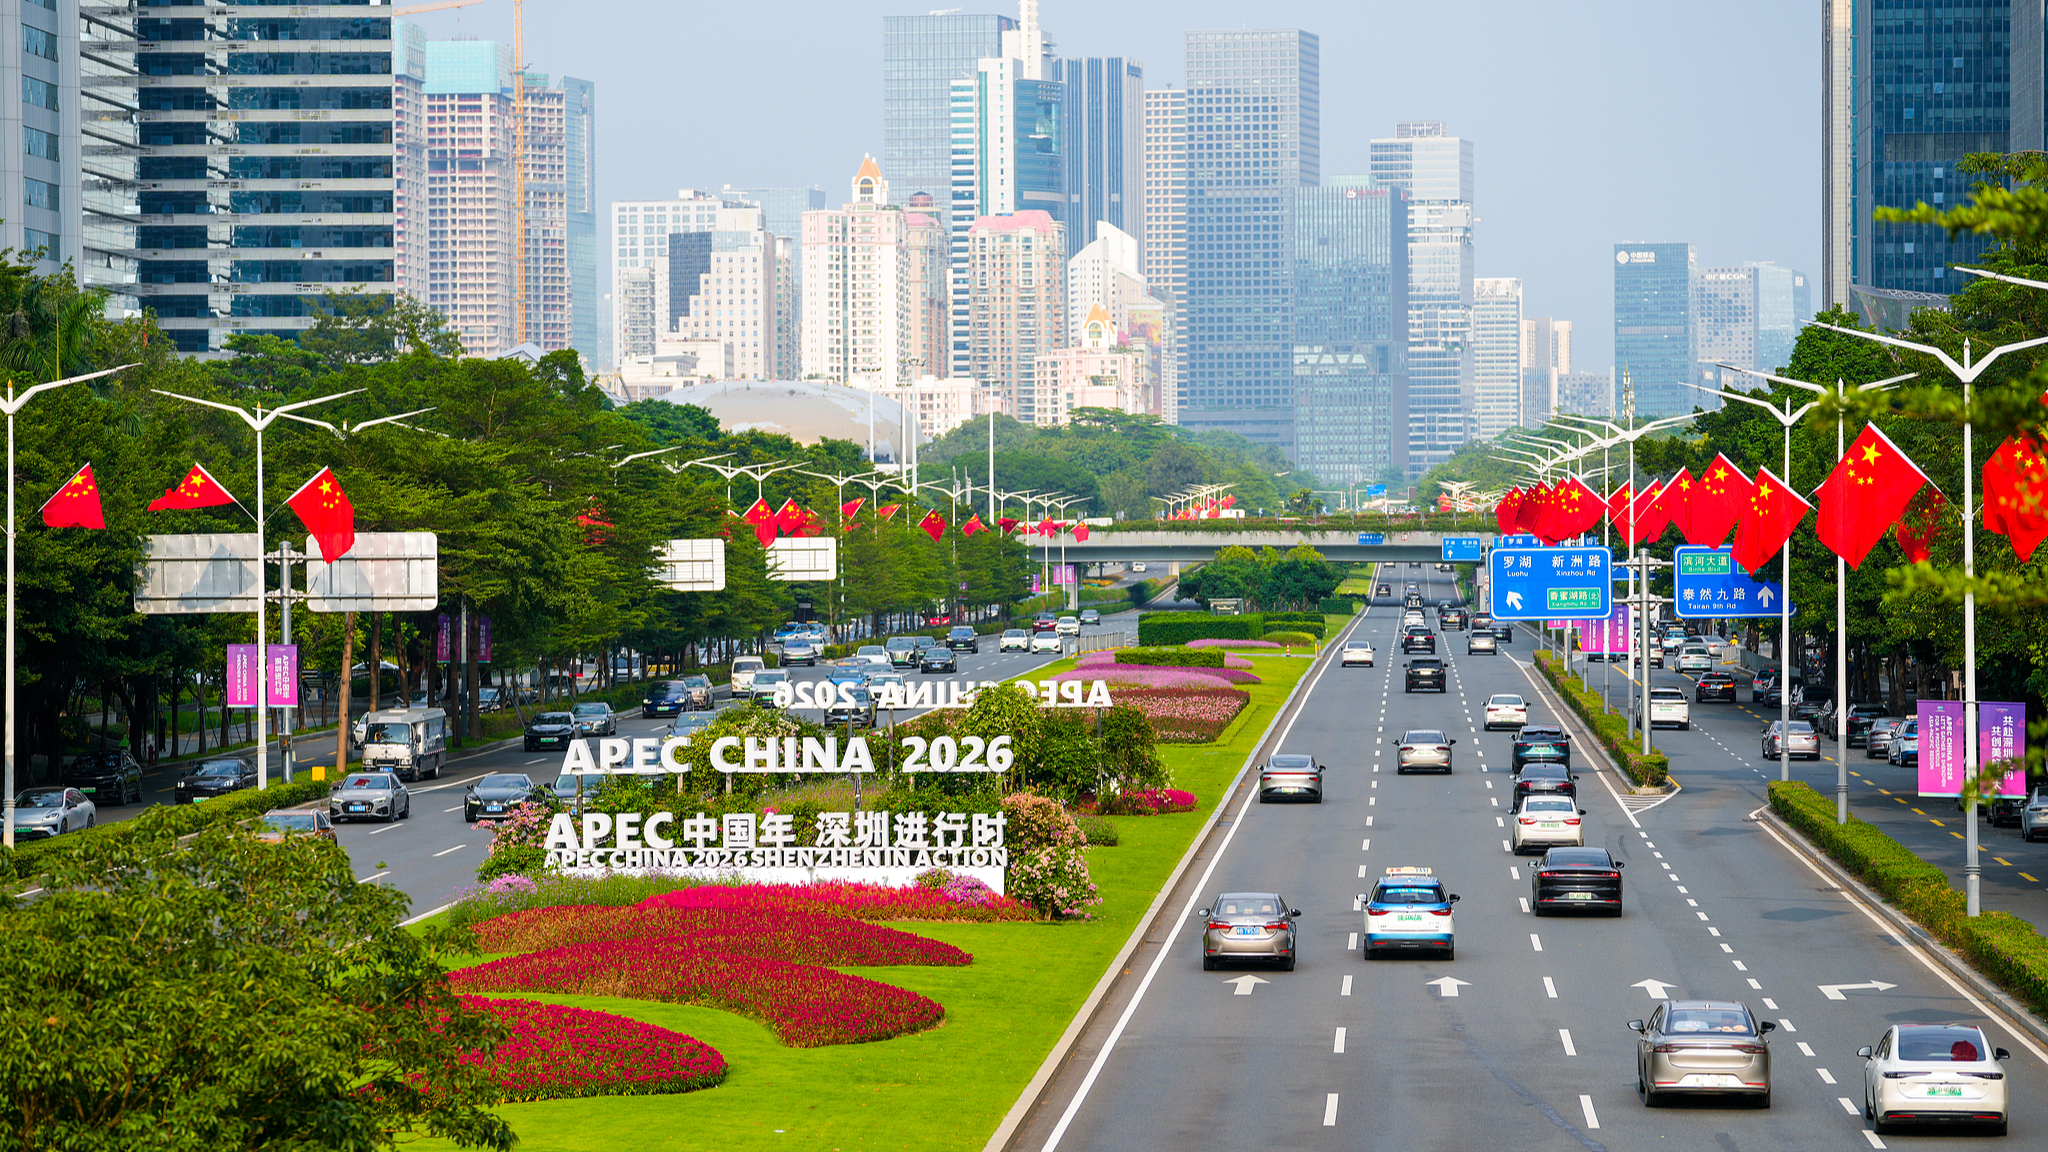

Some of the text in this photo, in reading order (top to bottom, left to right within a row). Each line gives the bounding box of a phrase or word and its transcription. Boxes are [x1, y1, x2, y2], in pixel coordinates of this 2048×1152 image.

[1503, 555, 1601, 569] 罗湖 新洲路
[1683, 556, 1727, 566] 滨河大道
[1683, 588, 1746, 601] 泰然九路
[561, 736, 1014, 774] APEC CHINA 2026
[1991, 726, 2002, 790] 共创美好太
[544, 811, 1008, 850] APEC中国年 深圳进行时
[544, 848, 1008, 869] APEC CHINA 2026 SHENZHEN IN ACTION
